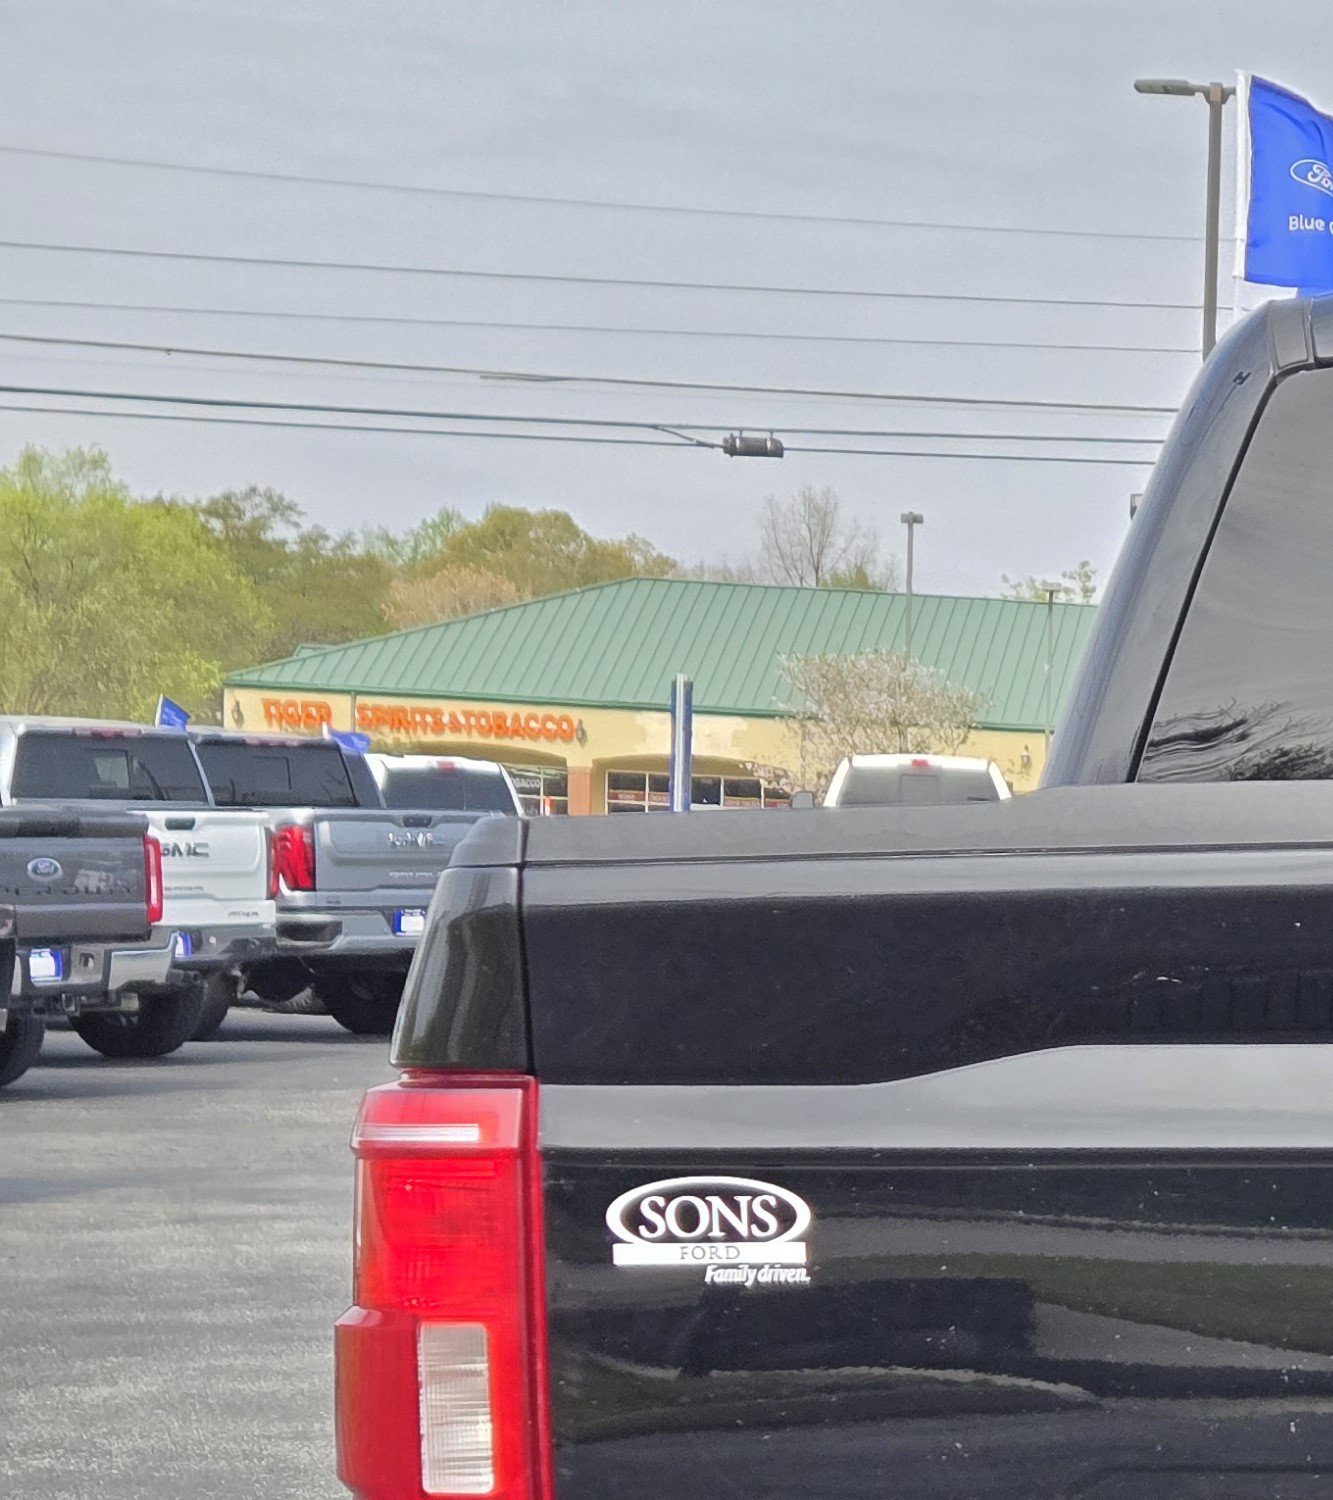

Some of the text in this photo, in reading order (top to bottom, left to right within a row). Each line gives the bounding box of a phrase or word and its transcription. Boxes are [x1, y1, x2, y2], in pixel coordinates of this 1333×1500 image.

[1288, 214, 1326, 231] Blue
[261, 698, 332, 729] TIGER
[356, 703, 445, 735] SPIRITS
[461, 710, 574, 742] TOBACCO
[638, 1195, 778, 1238] SONS
[680, 1246, 741, 1260] FORD
[704, 1265, 757, 1287] Family
